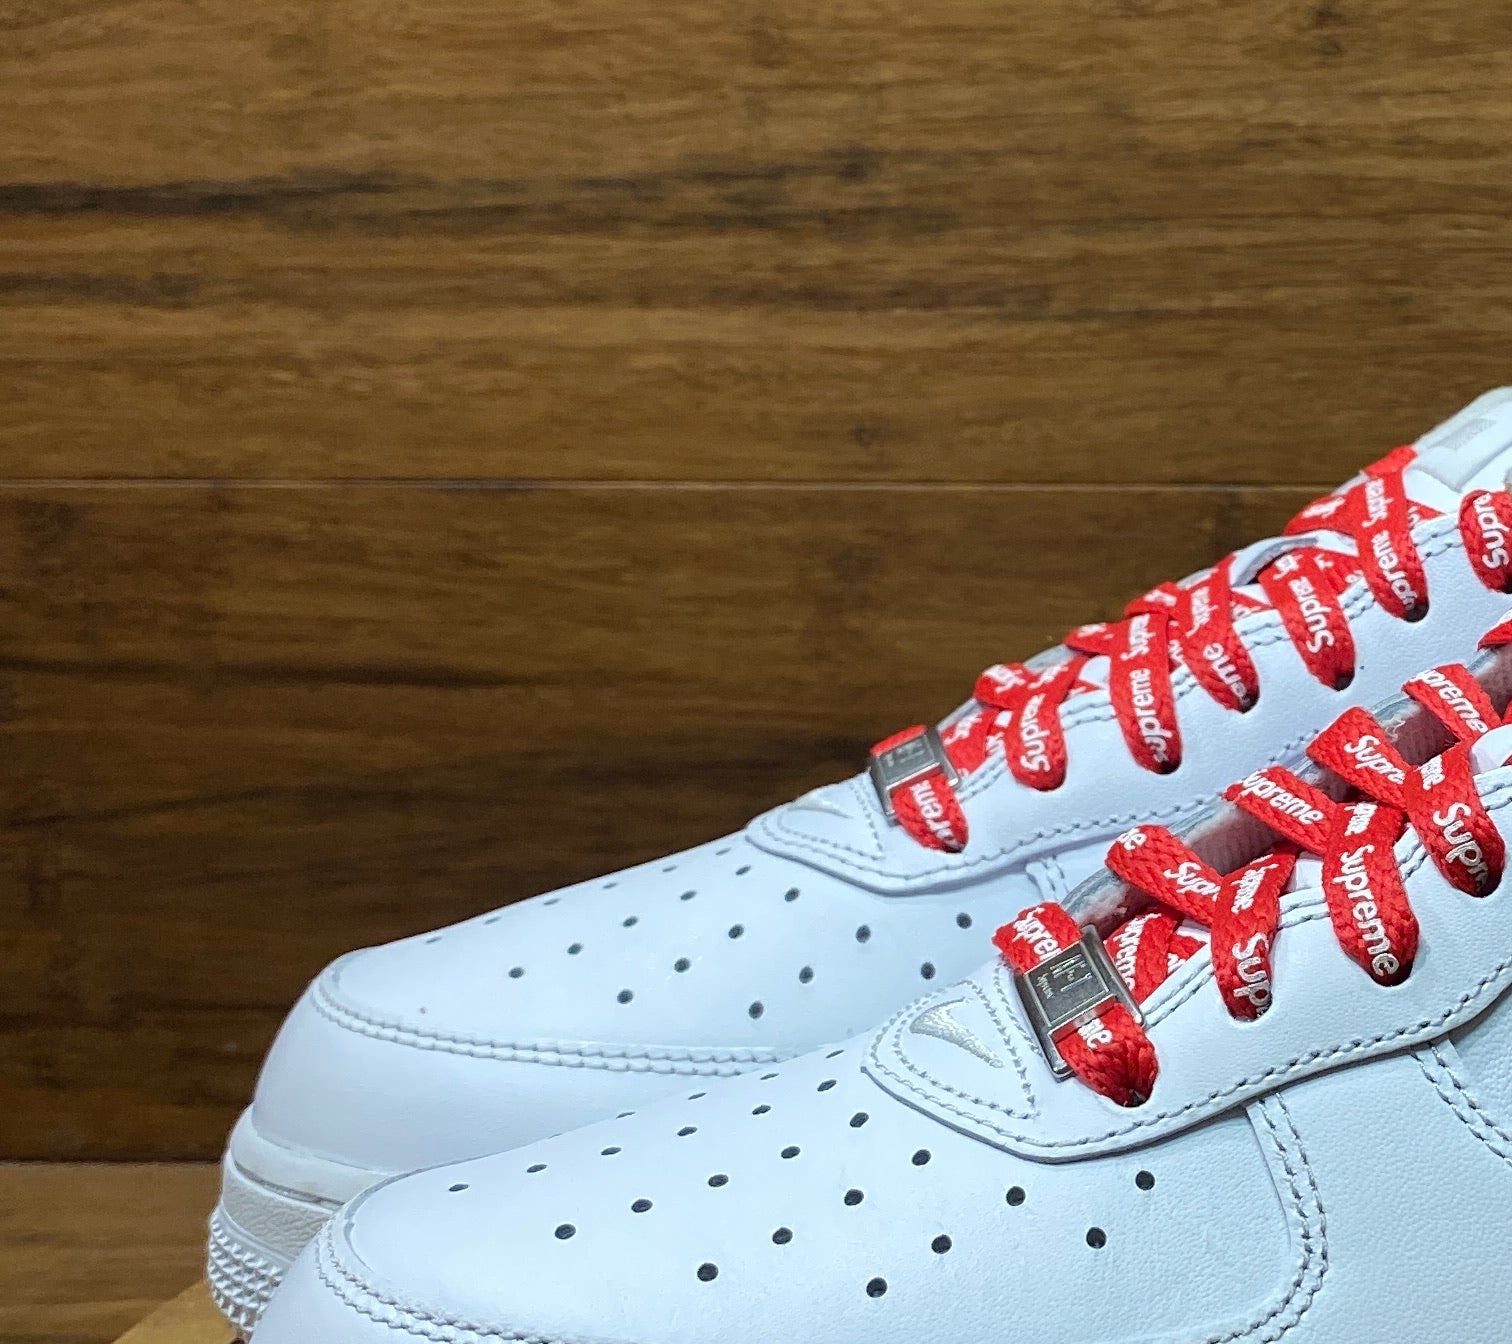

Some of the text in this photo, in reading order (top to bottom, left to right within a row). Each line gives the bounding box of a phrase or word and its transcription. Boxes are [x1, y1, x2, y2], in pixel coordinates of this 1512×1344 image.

[1472, 492, 1511, 570] Supre
[1343, 734, 1407, 786] Supre
[1163, 861, 1222, 902] Supr
[1332, 843, 1400, 977] Supreme
